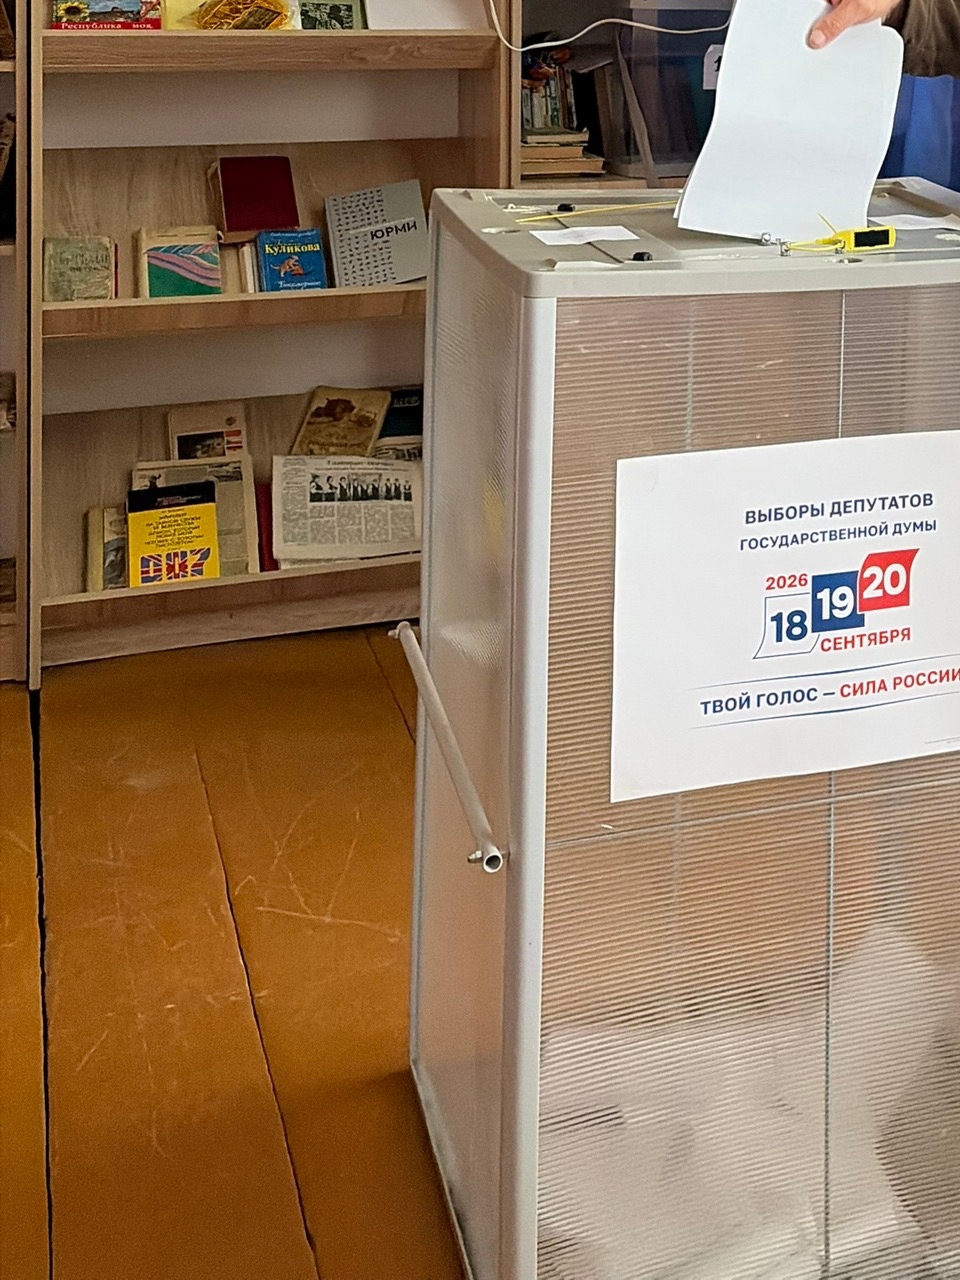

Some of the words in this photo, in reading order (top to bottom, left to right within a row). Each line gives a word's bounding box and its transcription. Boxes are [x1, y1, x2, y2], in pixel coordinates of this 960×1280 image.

[370, 221, 417, 240] ЮРМИ
[264, 243, 320, 256] Куликова
[745, 503, 825, 525] ВЫБОРЫ
[829, 493, 934, 518] ДЕПУТАТОВ
[739, 521, 889, 551] ГОСУДАРСТВЕННОЙ
[891, 520, 937, 536] ДУМЫ
[140, 547, 212, 584] 007
[765, 573, 808, 591] 2026
[770, 610, 809, 643] 18
[816, 586, 855, 621] 19
[862, 563, 908, 600] 20
[820, 627, 911, 652] СЕНТЯБРЯ
[700, 691, 751, 715] ТВОЙ
[756, 686, 818, 709] ГОЛОС
[839, 681, 888, 699] СИЛА
